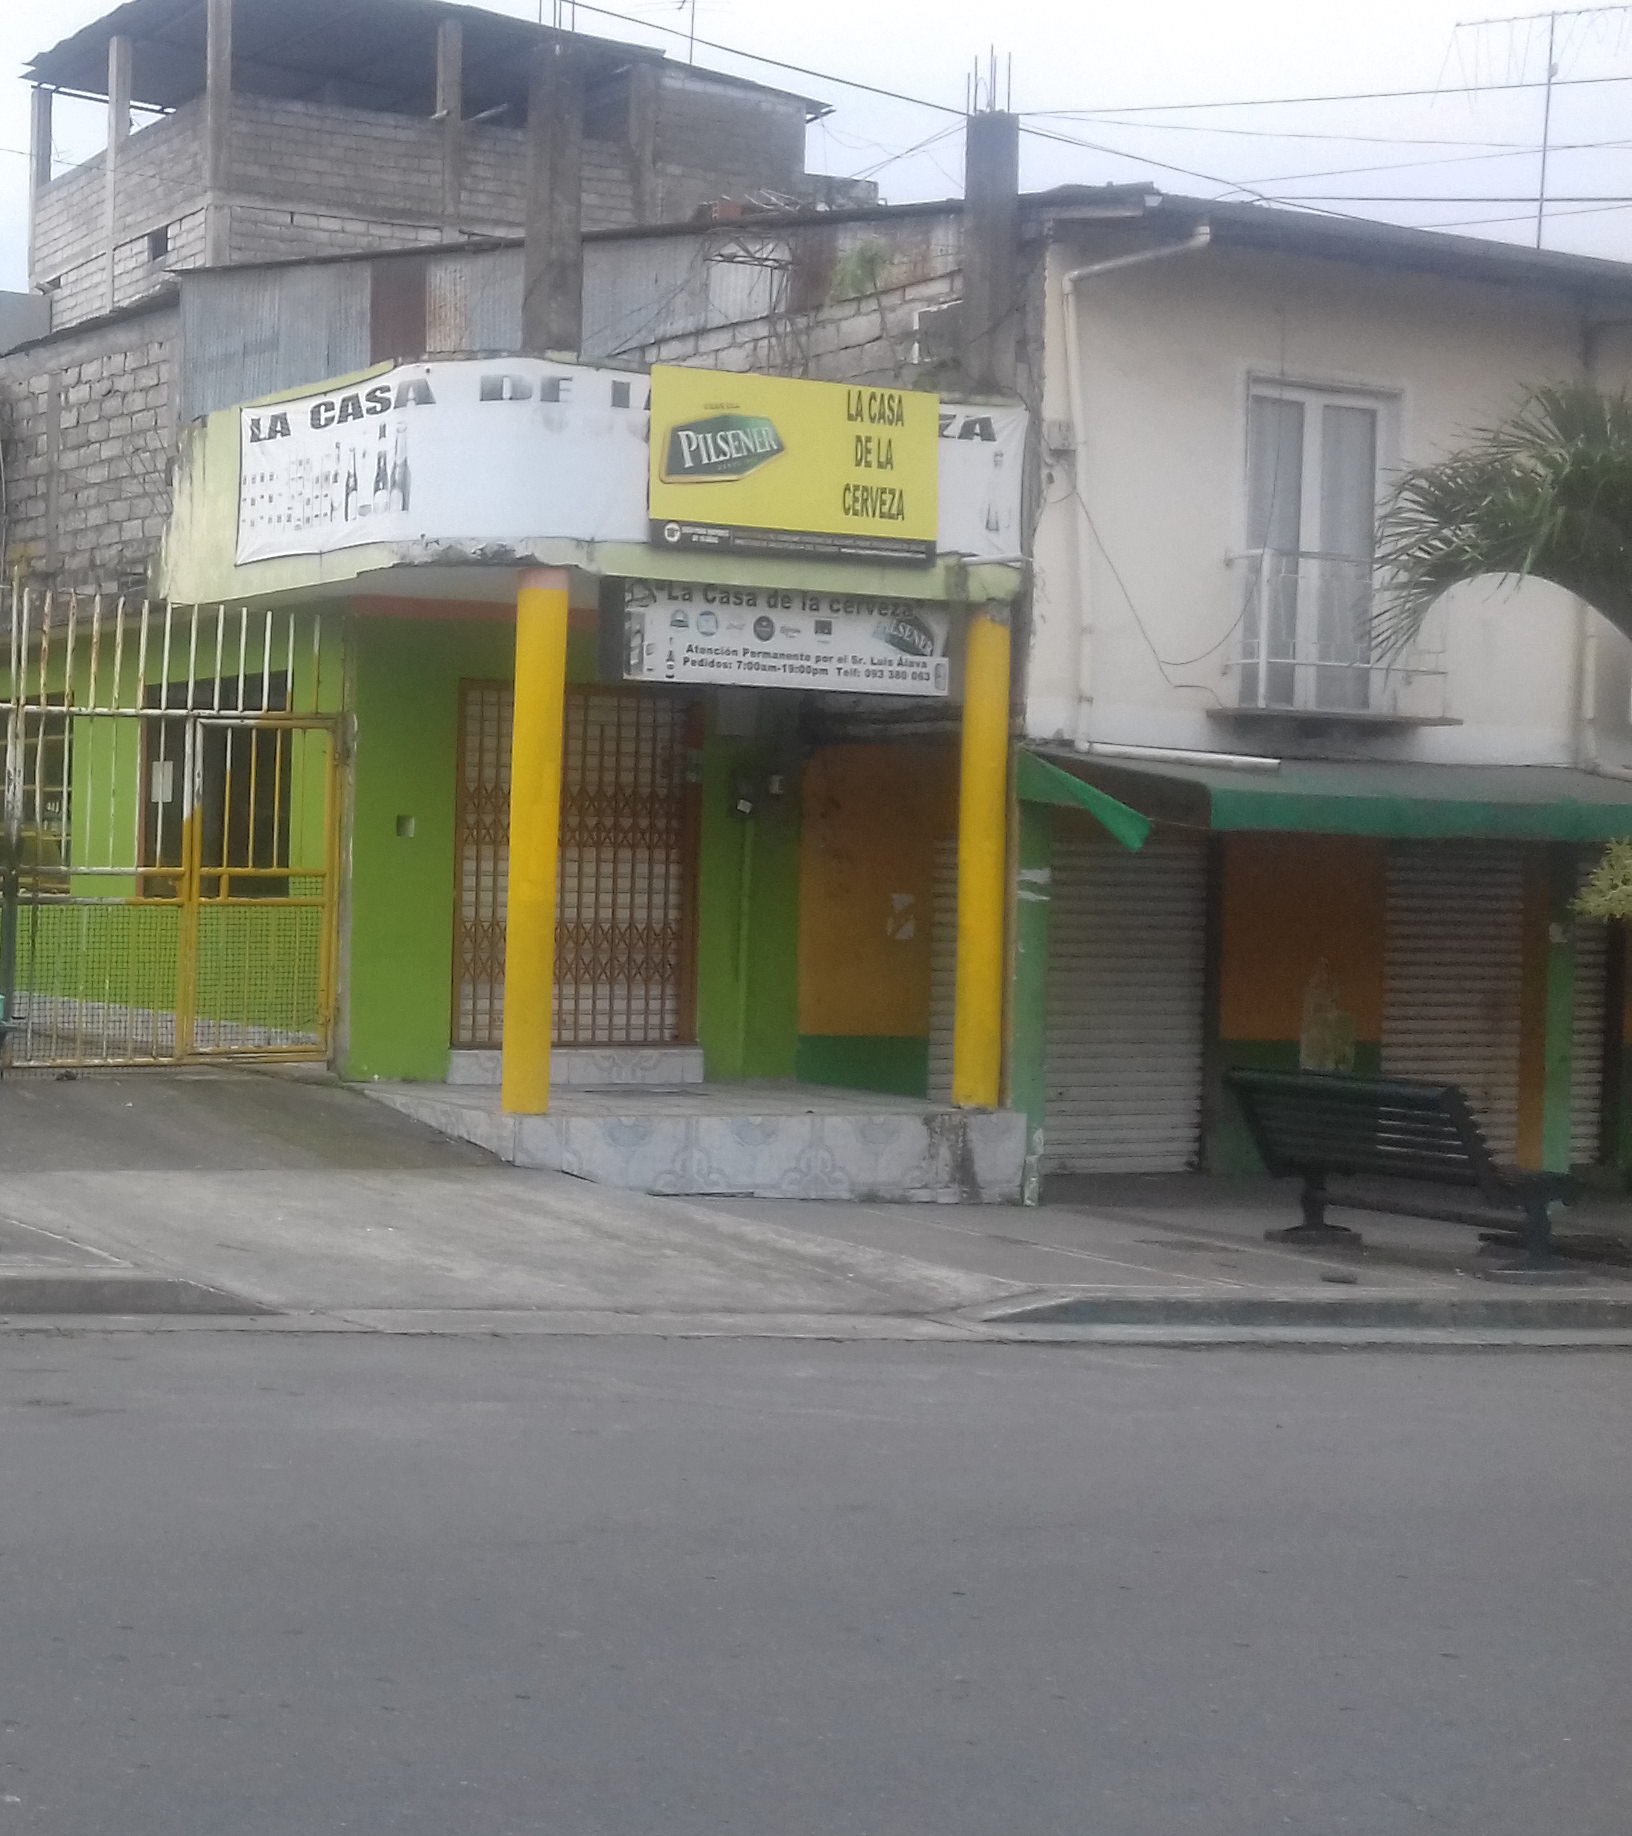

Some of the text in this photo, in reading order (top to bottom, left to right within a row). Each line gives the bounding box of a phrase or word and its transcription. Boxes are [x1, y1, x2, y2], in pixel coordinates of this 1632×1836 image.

[249, 411, 292, 443] LA
[309, 378, 436, 430] CASA
[847, 389, 864, 422] LA
[868, 391, 905, 427] CASA
[677, 426, 778, 468] PILSENER
[854, 434, 894, 470] DE LA
[842, 483, 905, 521] CERVEZA
[702, 584, 758, 607] Casa
[766, 590, 792, 610] de
[801, 591, 820, 612] la
[682, 656, 732, 669] Pedidos:
[742, 646, 811, 662] Permanente
[815, 654, 833, 664] por
[837, 654, 847, 663] el
[851, 654, 867, 665] Sr.
[870, 656, 894, 666] Luis
